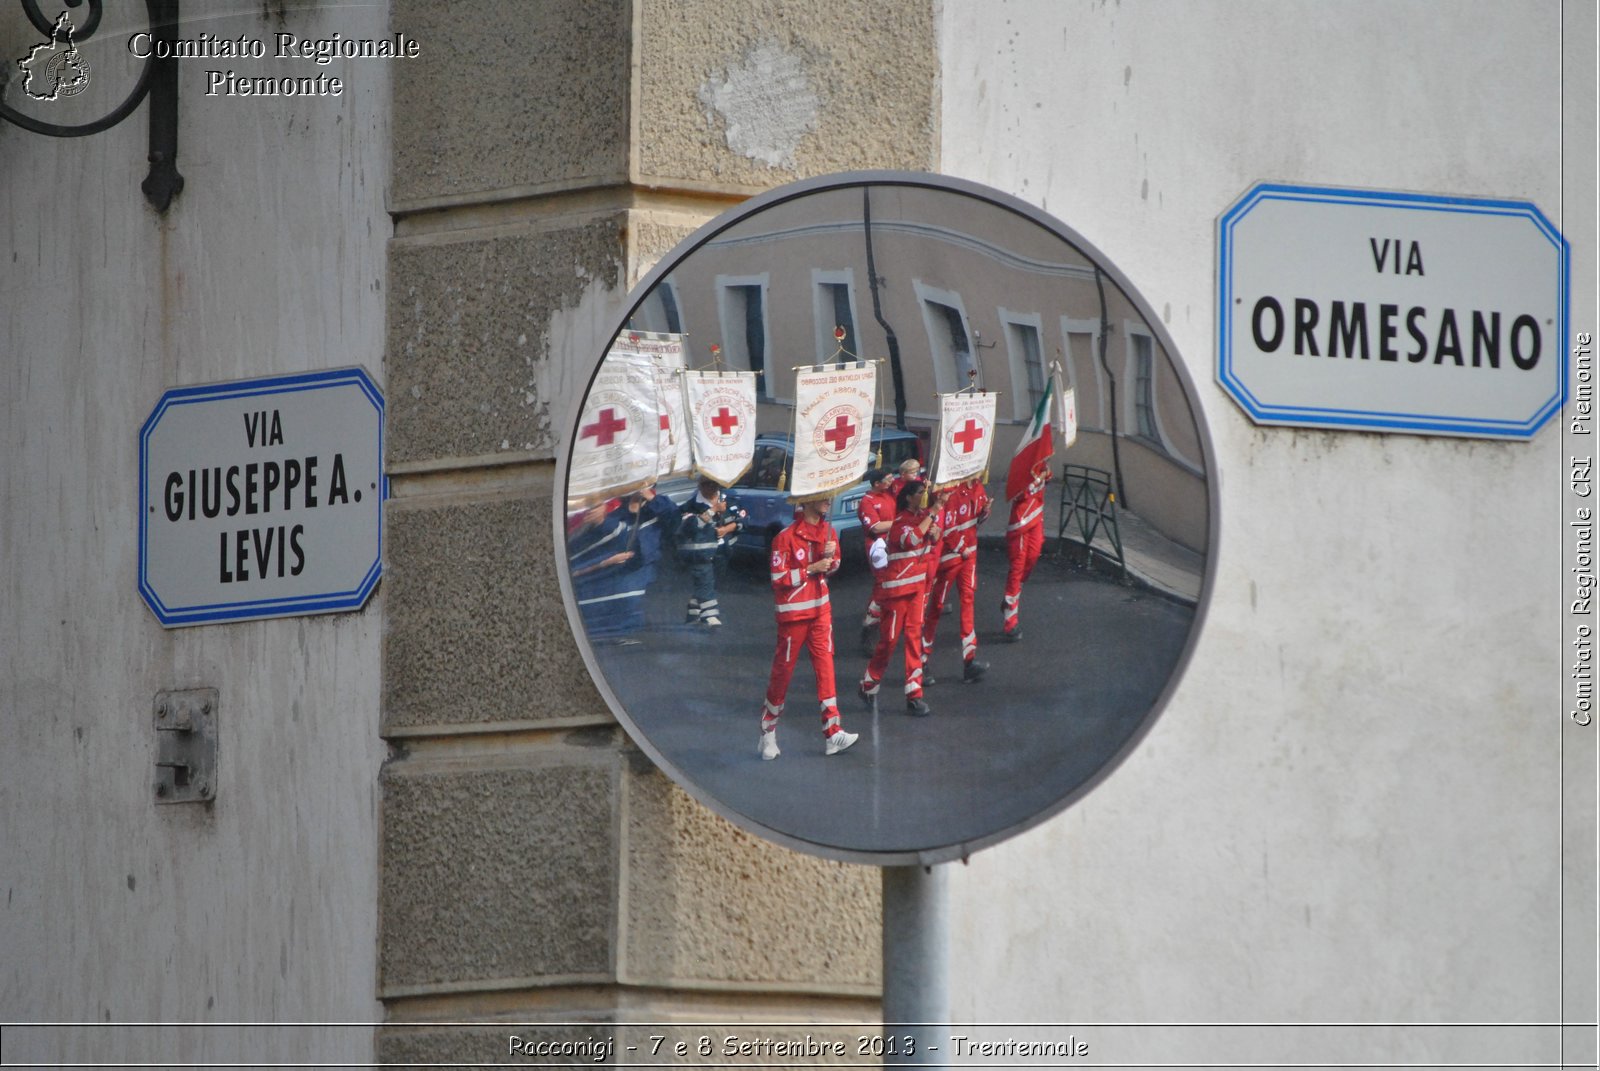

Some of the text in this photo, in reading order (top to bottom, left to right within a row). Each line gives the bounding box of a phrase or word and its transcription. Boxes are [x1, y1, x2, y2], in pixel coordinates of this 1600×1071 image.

[1370, 237, 1425, 276] VIA
[1252, 296, 1542, 371] ORMESANO
[243, 409, 284, 448] VIA
[164, 453, 362, 523] GIUSEPPE A.
[220, 524, 305, 584] LEVIS
